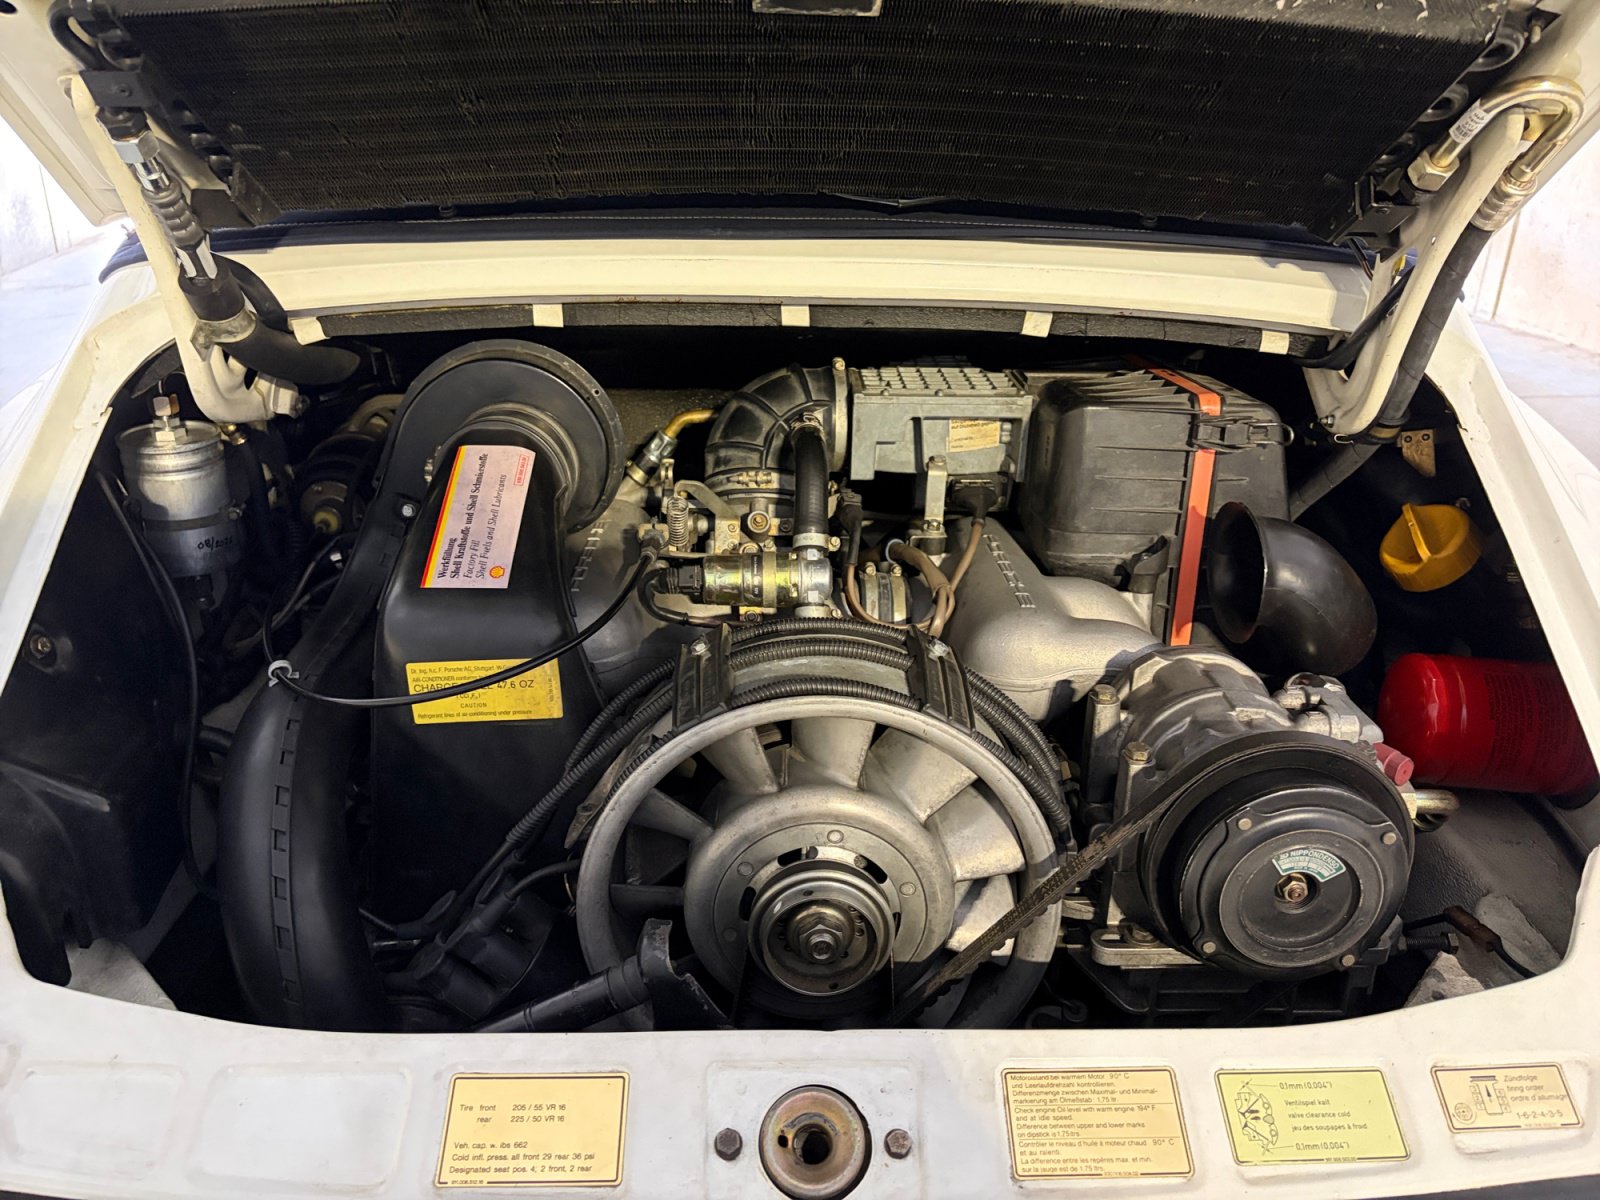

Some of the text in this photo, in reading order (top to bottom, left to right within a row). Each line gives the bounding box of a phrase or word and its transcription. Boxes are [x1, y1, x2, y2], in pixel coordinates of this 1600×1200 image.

[450, 453, 489, 578] Shell Kraftstoffe und Shell Schmierstoffe
[476, 474, 507, 578] Shell Fuels and Shell Lubricants
[437, 538, 458, 578] Werkfüllung
[463, 539, 480, 578] Factory Fill
[520, 680, 534, 688] OZ
[1291, 850, 1340, 868] NIPPONDENSO
[460, 1104, 473, 1112] Tire
[480, 1104, 496, 1112] front
[1517, 1110, 1563, 1119] 1-6-2-4-3-5
[1028, 1130, 1050, 1138] dipstick
[585, 1153, 595, 1161] psi
[450, 1166, 490, 1174] Designated
